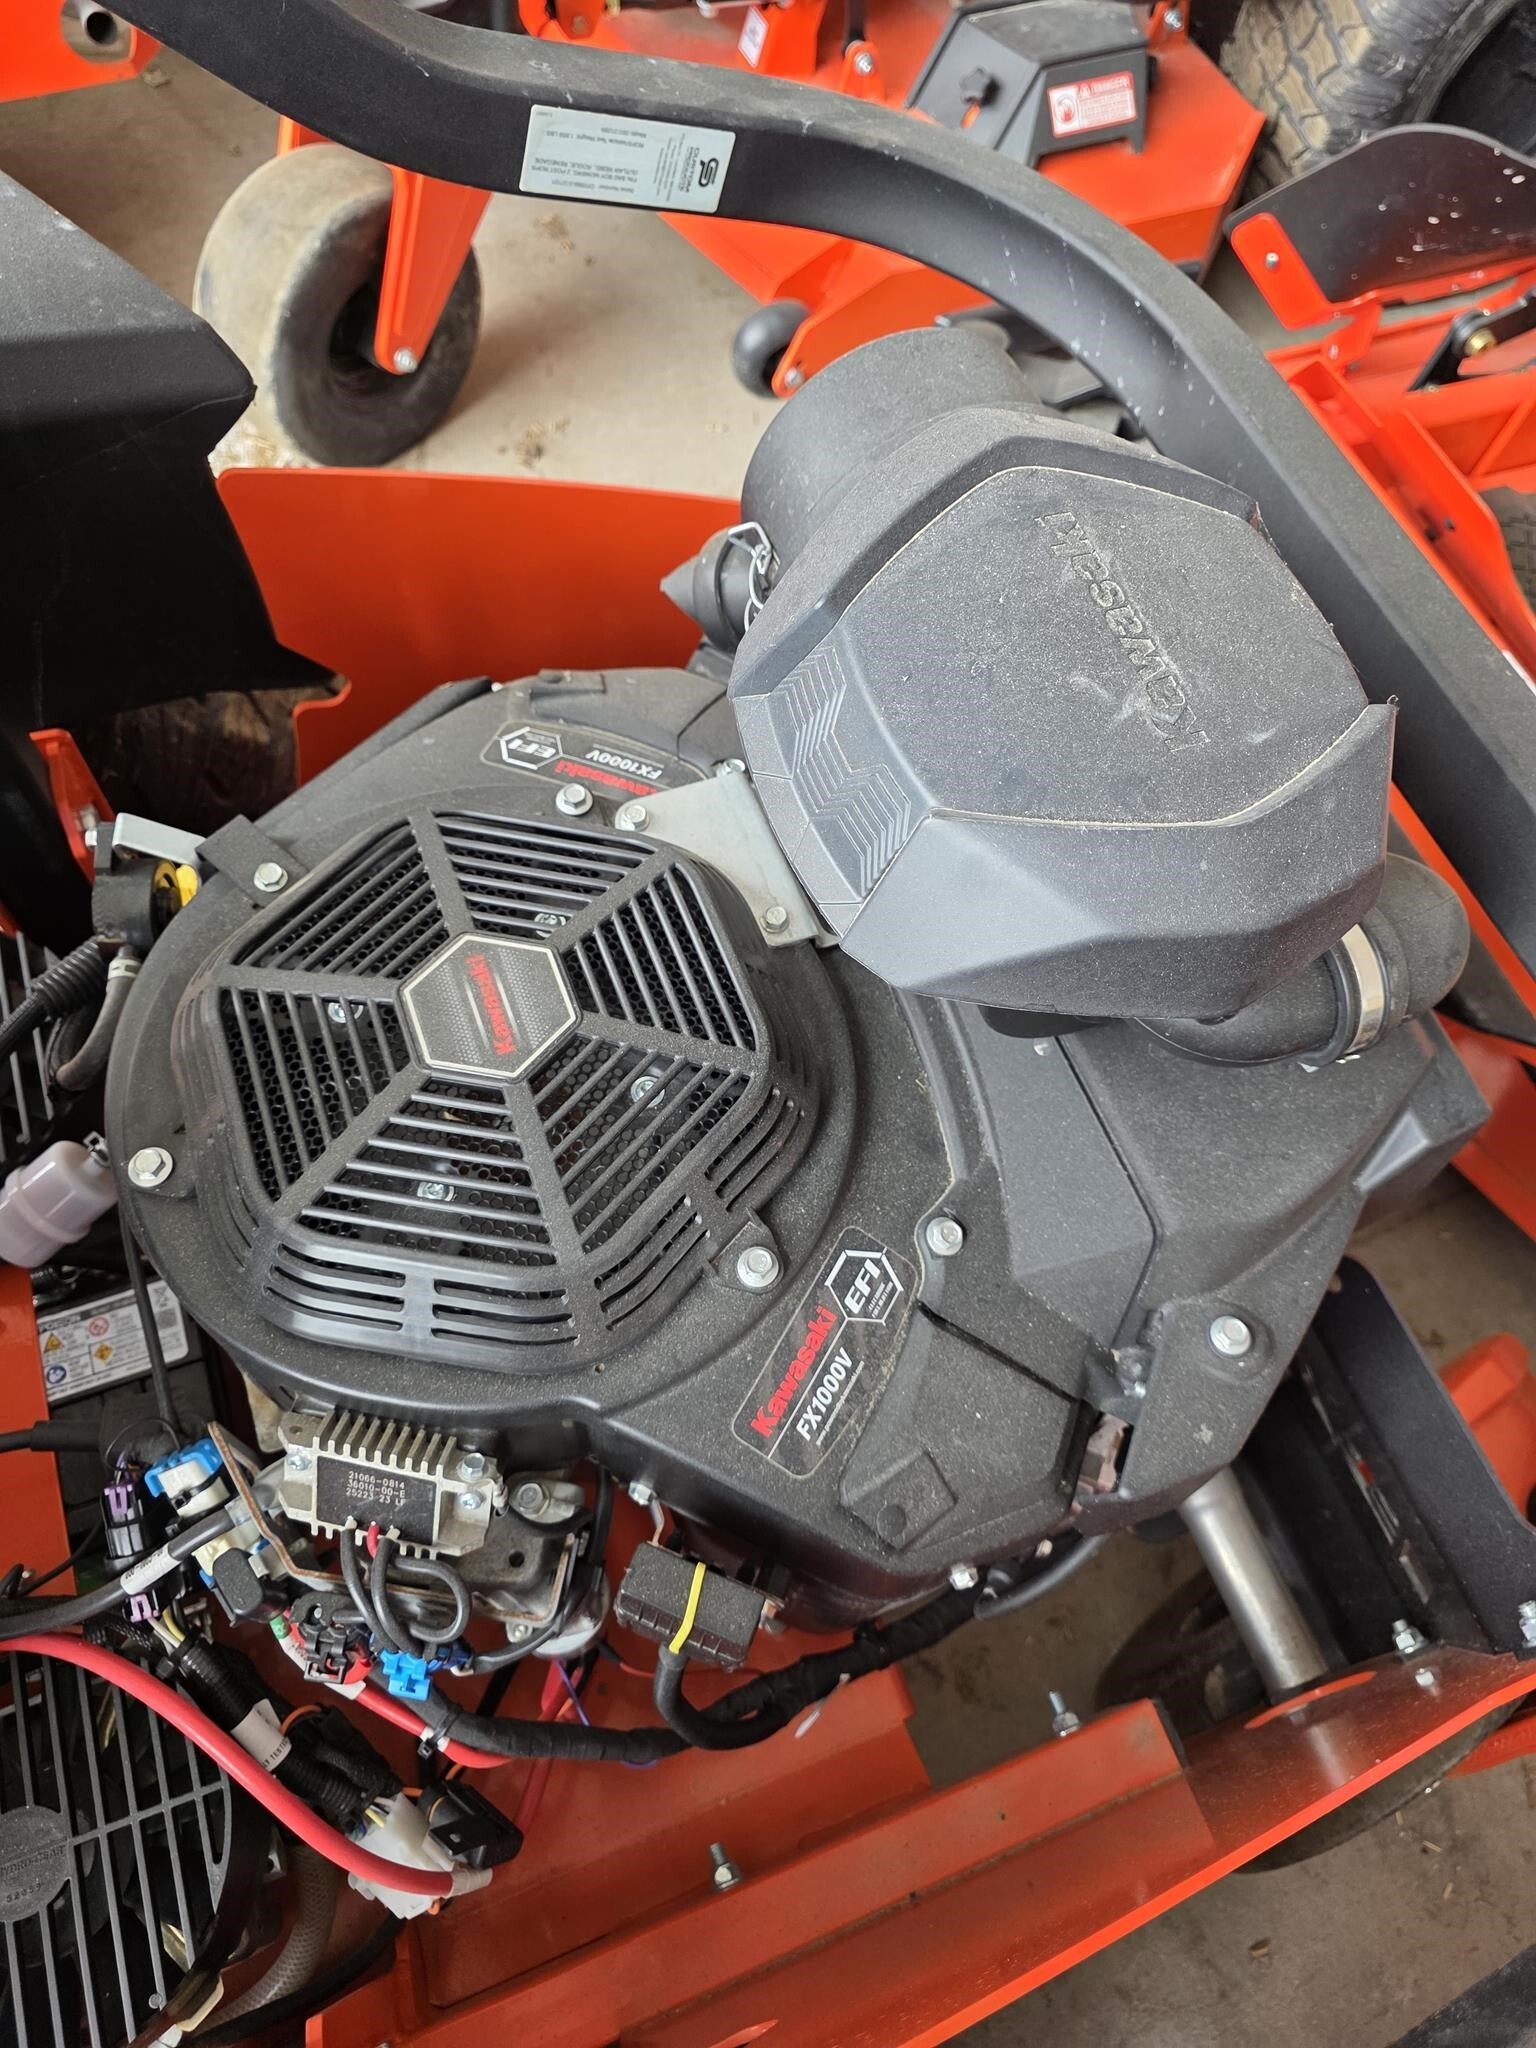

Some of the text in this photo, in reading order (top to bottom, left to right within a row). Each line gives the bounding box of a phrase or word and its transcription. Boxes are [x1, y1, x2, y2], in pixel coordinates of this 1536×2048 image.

[1034, 512, 1211, 750] Kawasaki
[507, 738, 556, 758] EFI
[586, 749, 663, 780] FX1000V
[555, 759, 657, 797] awasaki
[465, 953, 518, 1056] Kawasaki
[844, 1258, 881, 1314] EFI
[750, 1305, 838, 1438] Kawasaki
[796, 1347, 853, 1441] FX1000V
[348, 1470, 405, 1489] 21066-0814
